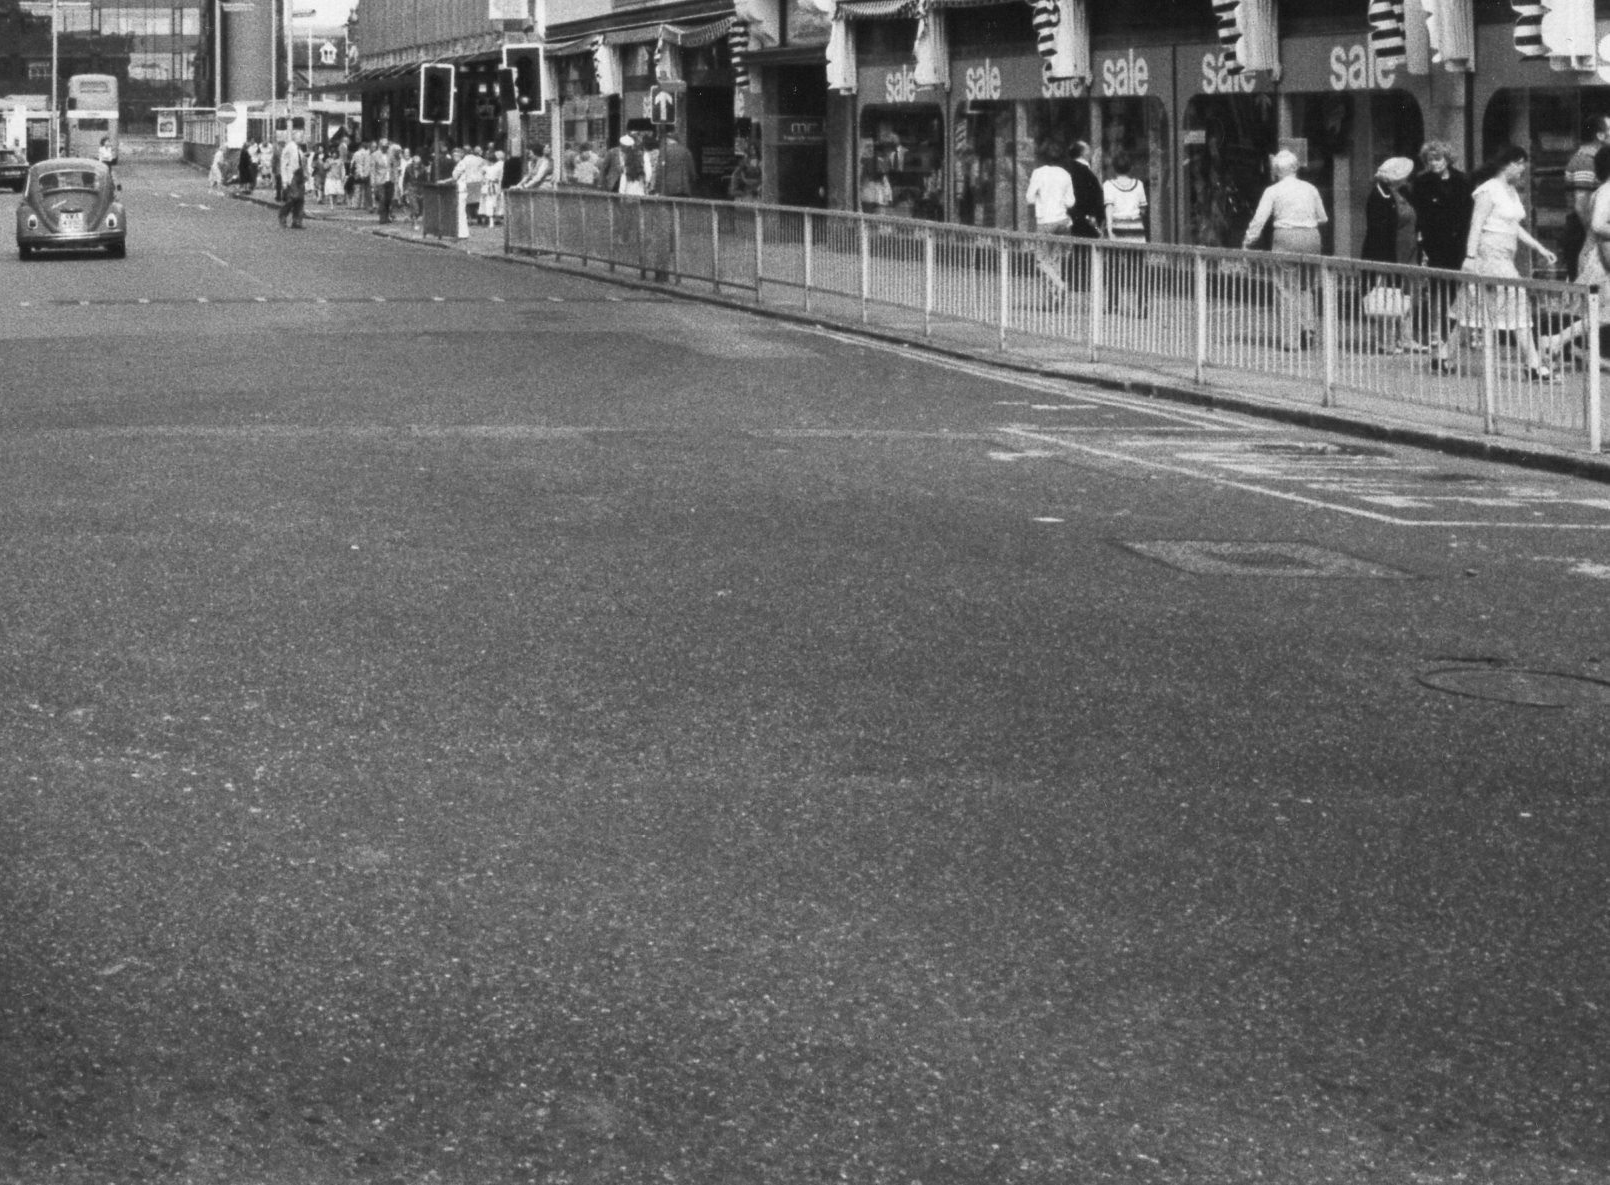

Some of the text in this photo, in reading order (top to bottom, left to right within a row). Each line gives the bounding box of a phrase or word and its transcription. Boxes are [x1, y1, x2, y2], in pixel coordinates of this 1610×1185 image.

[886, 64, 916, 103] sale
[966, 57, 1001, 100] sale
[1102, 48, 1149, 97] sale
[1329, 32, 1397, 91] sale
